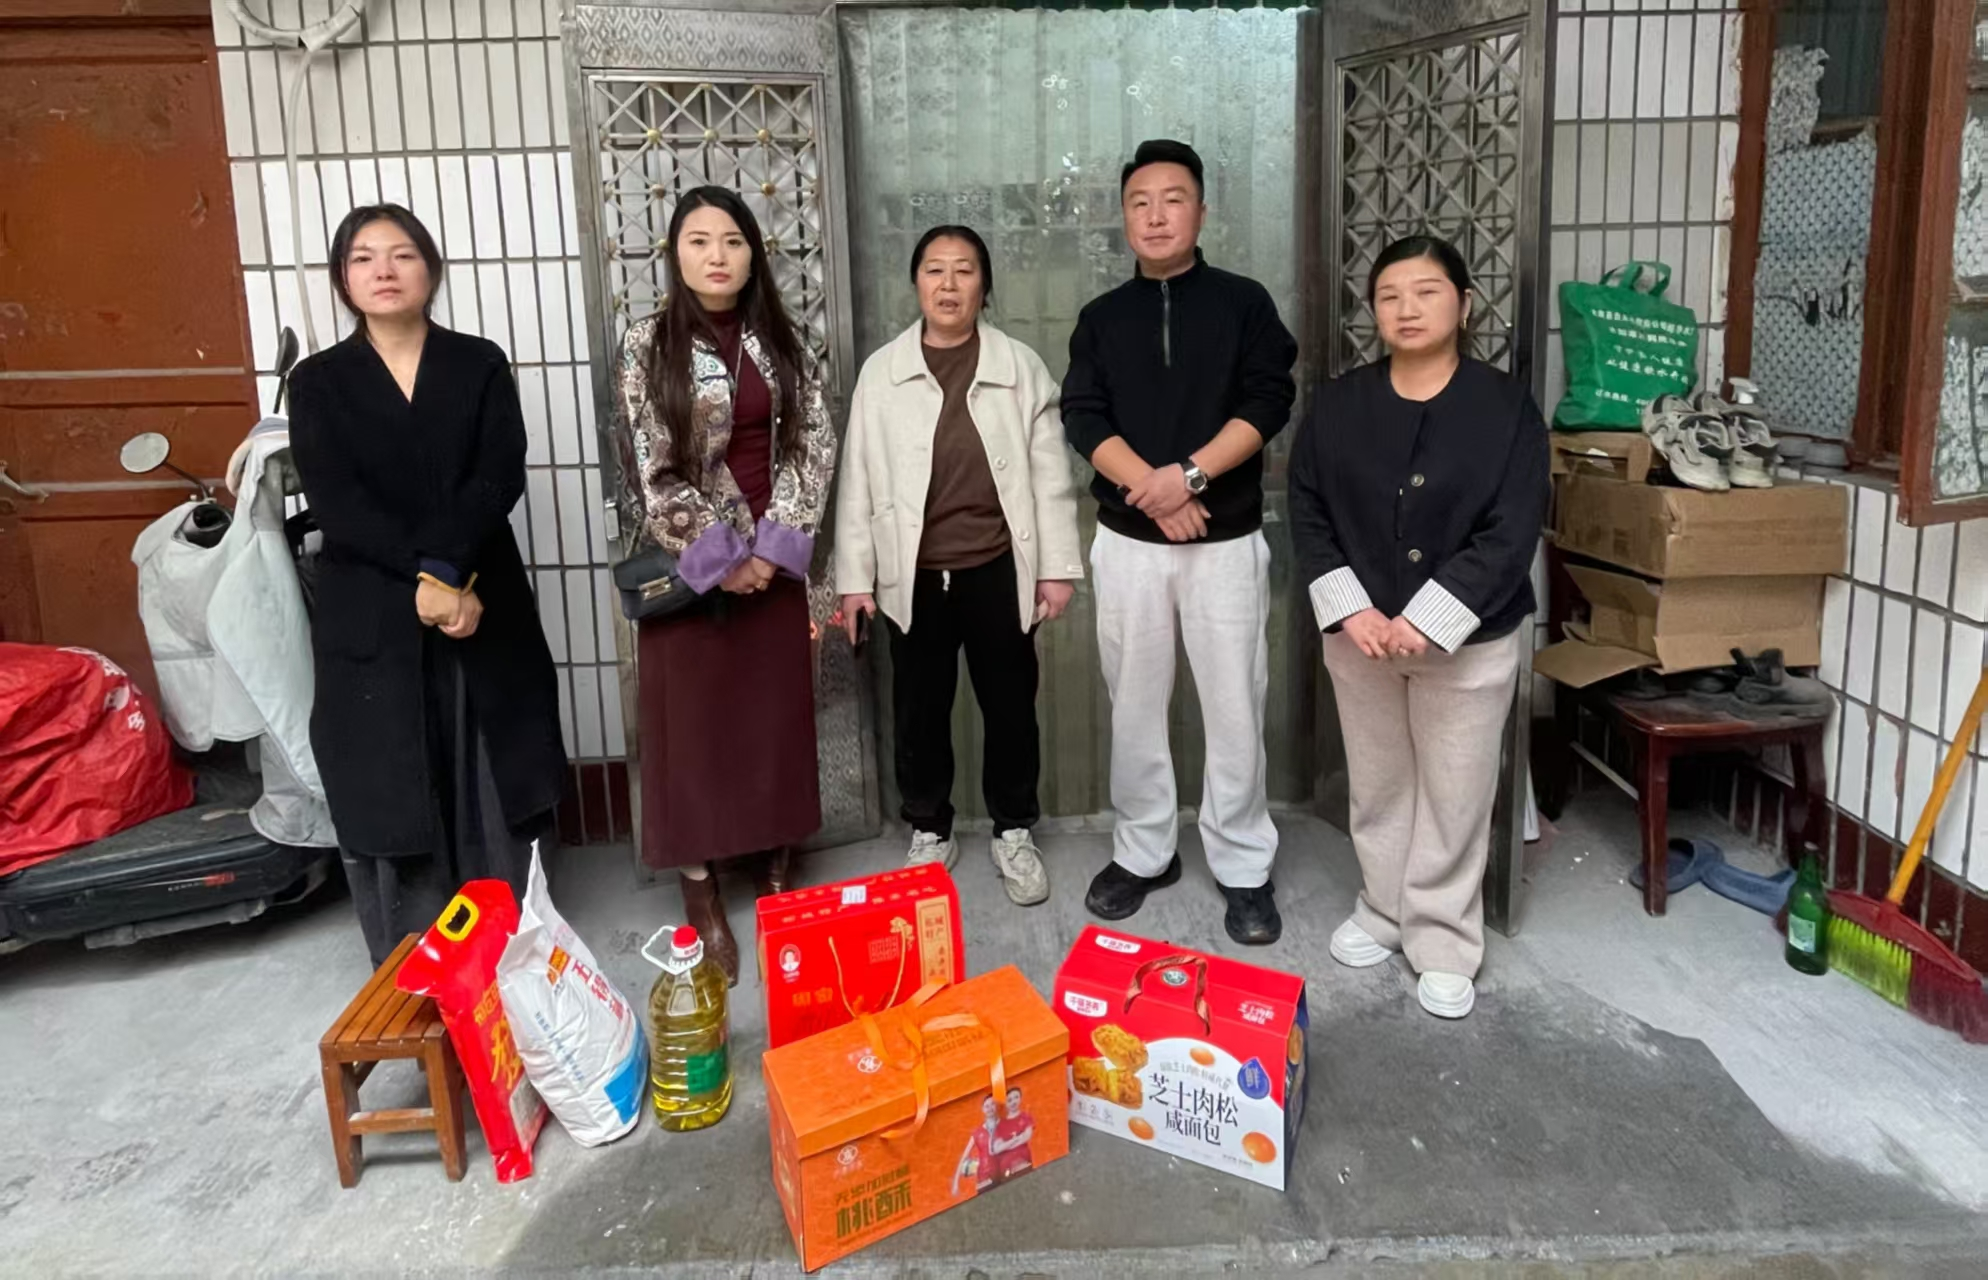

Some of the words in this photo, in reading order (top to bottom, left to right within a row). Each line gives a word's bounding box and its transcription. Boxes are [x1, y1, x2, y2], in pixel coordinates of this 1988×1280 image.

[1148, 1073, 1239, 1127] 芝士肉松
[1165, 1110, 1221, 1146] 咸面包
[836, 1180, 912, 1238] 桃酥
